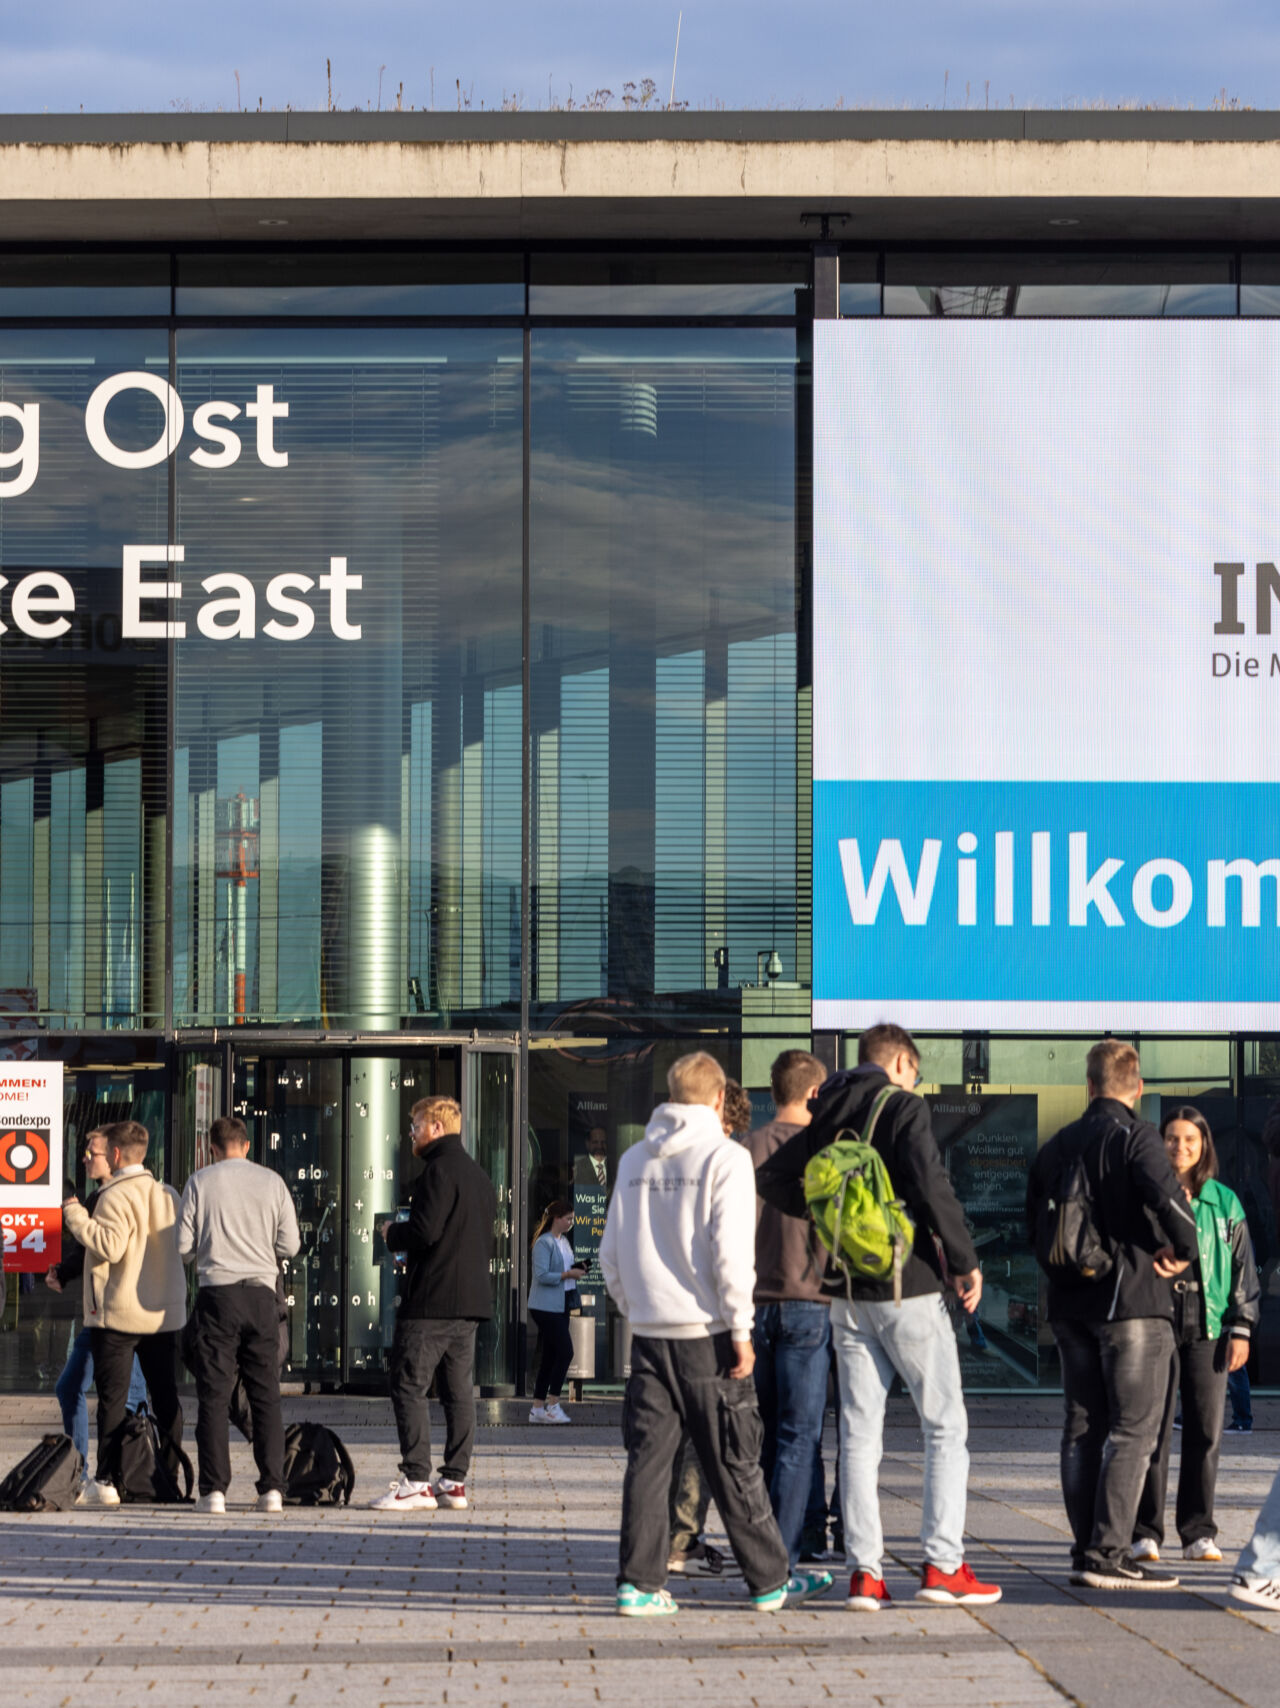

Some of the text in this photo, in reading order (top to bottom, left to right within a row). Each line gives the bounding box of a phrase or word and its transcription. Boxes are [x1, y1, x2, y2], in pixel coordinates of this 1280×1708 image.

[85, 371, 290, 470] Ost
[0, 571, 76, 640] e
[122, 544, 362, 641] East
[1212, 652, 1260, 678] Die
[932, 1103, 966, 1113] Allianz
[0, 1114, 51, 1128] ondexpo
[575, 1193, 596, 1204] Was
[591, 1204, 605, 1215] Sie
[1, 1213, 44, 1227] OKT.
[575, 1215, 591, 1225] Wir
